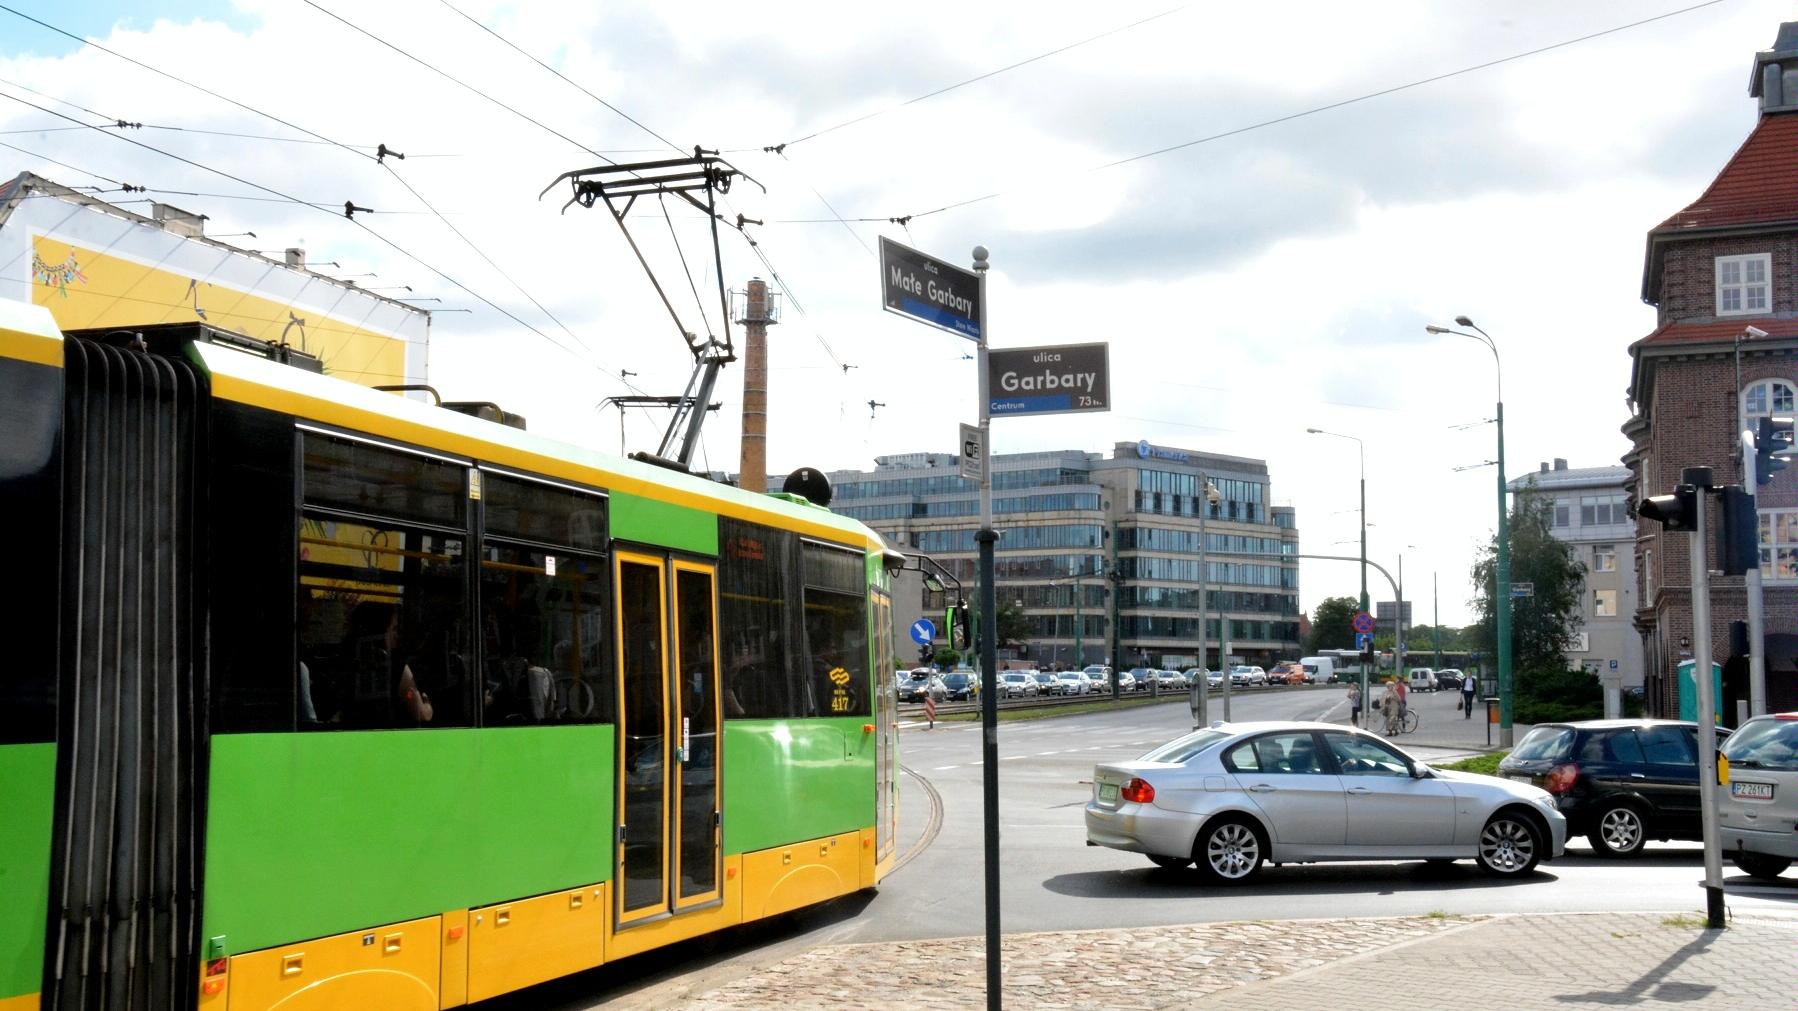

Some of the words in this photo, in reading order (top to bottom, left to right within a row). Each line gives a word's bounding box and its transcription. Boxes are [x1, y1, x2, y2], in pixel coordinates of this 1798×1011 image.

[924, 261, 938, 274] ulica
[891, 264, 922, 296] Małe
[928, 280, 972, 320] Garbary
[1033, 352, 1062, 363] ulica
[1001, 369, 1096, 393] Garbary
[991, 402, 1025, 410] Centrum
[1079, 396, 1092, 407] 73
[832, 697, 849, 712] 417
[1736, 783, 1747, 795] PZ
